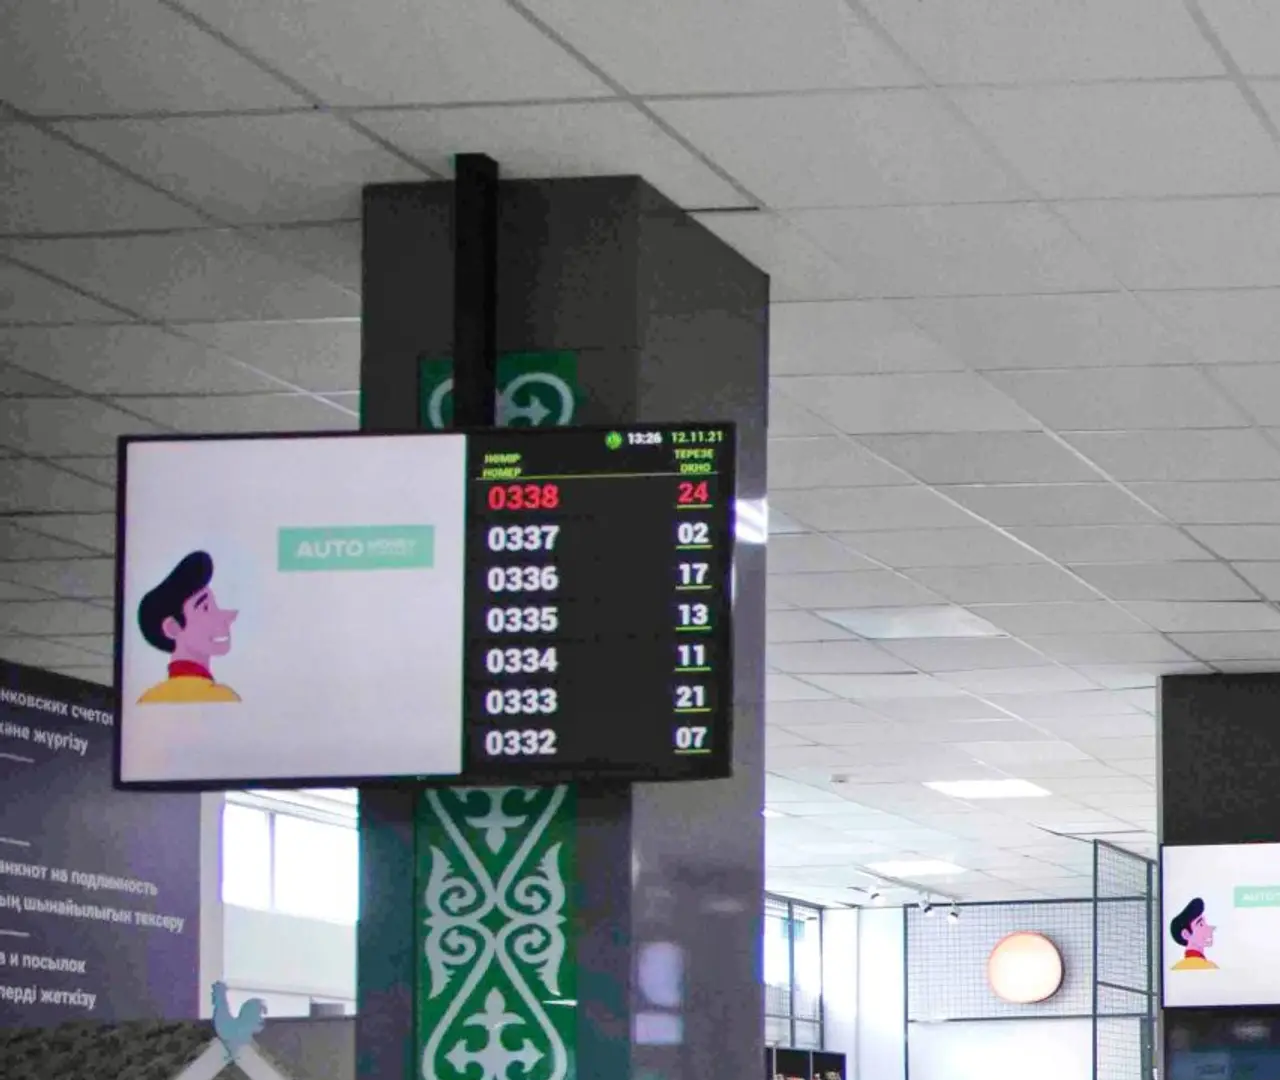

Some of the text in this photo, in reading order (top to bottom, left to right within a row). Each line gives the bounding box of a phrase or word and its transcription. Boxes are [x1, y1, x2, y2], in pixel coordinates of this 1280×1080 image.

[627, 431, 723, 445] 13:26 12.11.21
[679, 462, 711, 473] ОКНО
[488, 481, 709, 510] 0338 24
[297, 539, 365, 558] AUTO
[487, 522, 709, 551] 0337 02
[487, 563, 709, 592] 0336 17
[486, 603, 709, 633] 0335 13
[486, 644, 706, 674] 0334 11
[485, 685, 705, 714] 0333 21
[34, 729, 88, 757] жүргізу
[485, 726, 708, 755] 0332 07
[51, 868, 68, 883] на
[72, 871, 158, 896] подлинность
[134, 911, 185, 933] тексеру
[23, 955, 86, 973] посылок
[41, 988, 96, 1010] жеткізу
